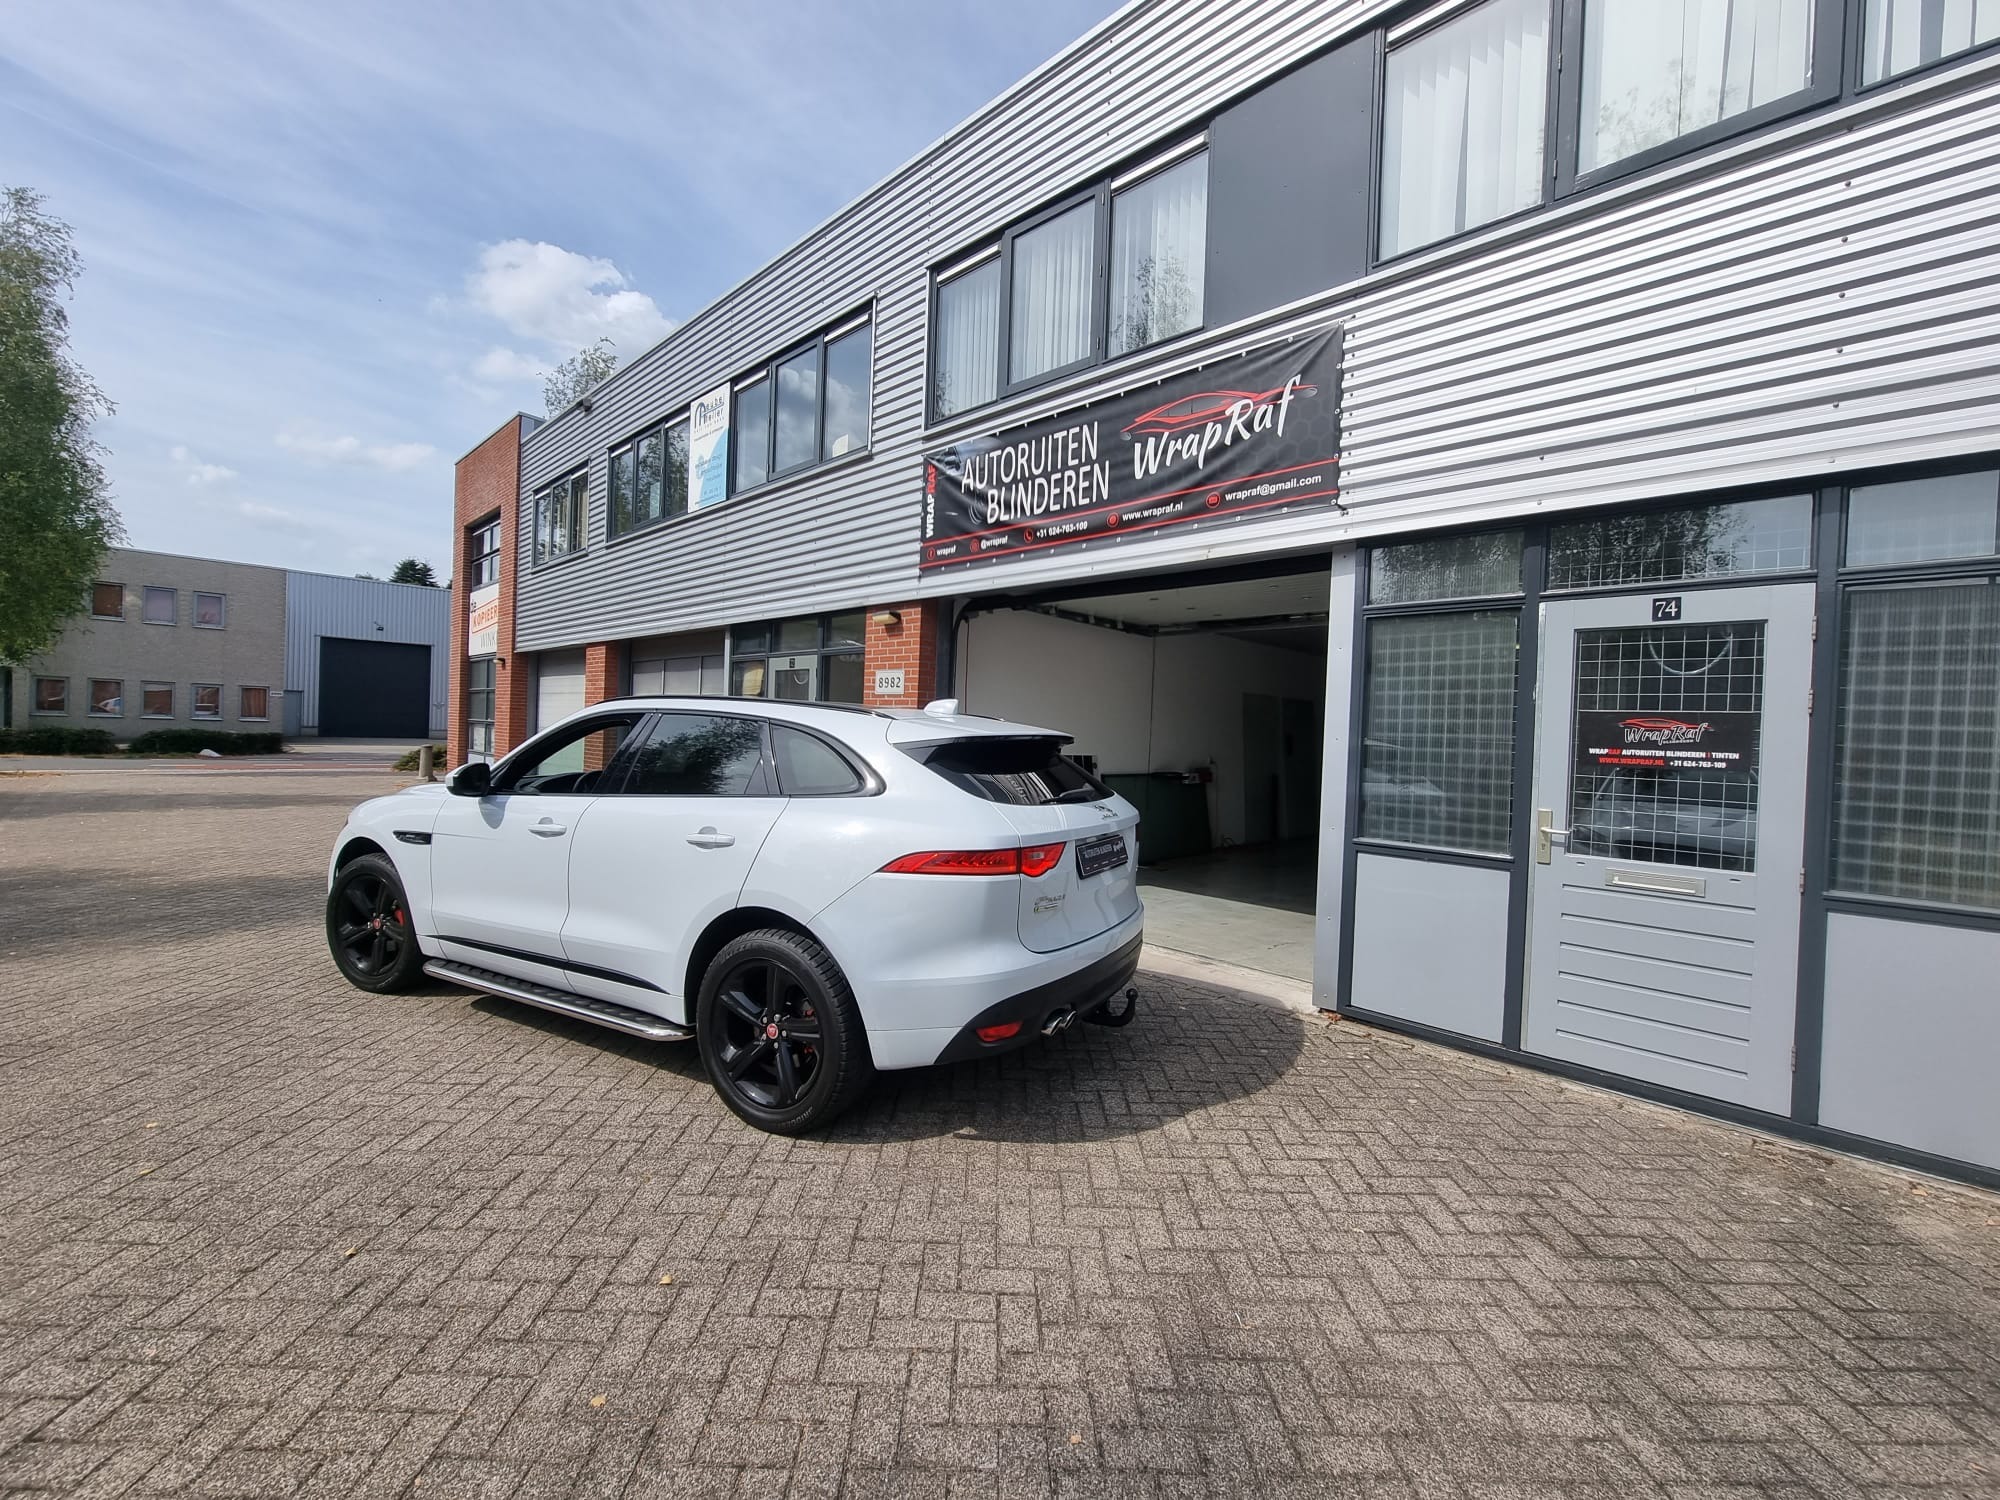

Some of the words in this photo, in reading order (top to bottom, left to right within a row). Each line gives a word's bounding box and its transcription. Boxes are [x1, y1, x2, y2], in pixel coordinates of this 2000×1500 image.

[1133, 374, 1301, 480] WrapRaf
[961, 420, 1098, 494] AUTORUITEN
[986, 461, 1110, 525] BLINDEREN
[1225, 475, 1322, 501] wrapraf@gmail.com
[1122, 502, 1183, 521] www.wrapraf.nl
[1655, 600, 1678, 617] 74
[878, 676, 901, 688] 8982
[1624, 722, 1709, 746] WrapRaf
